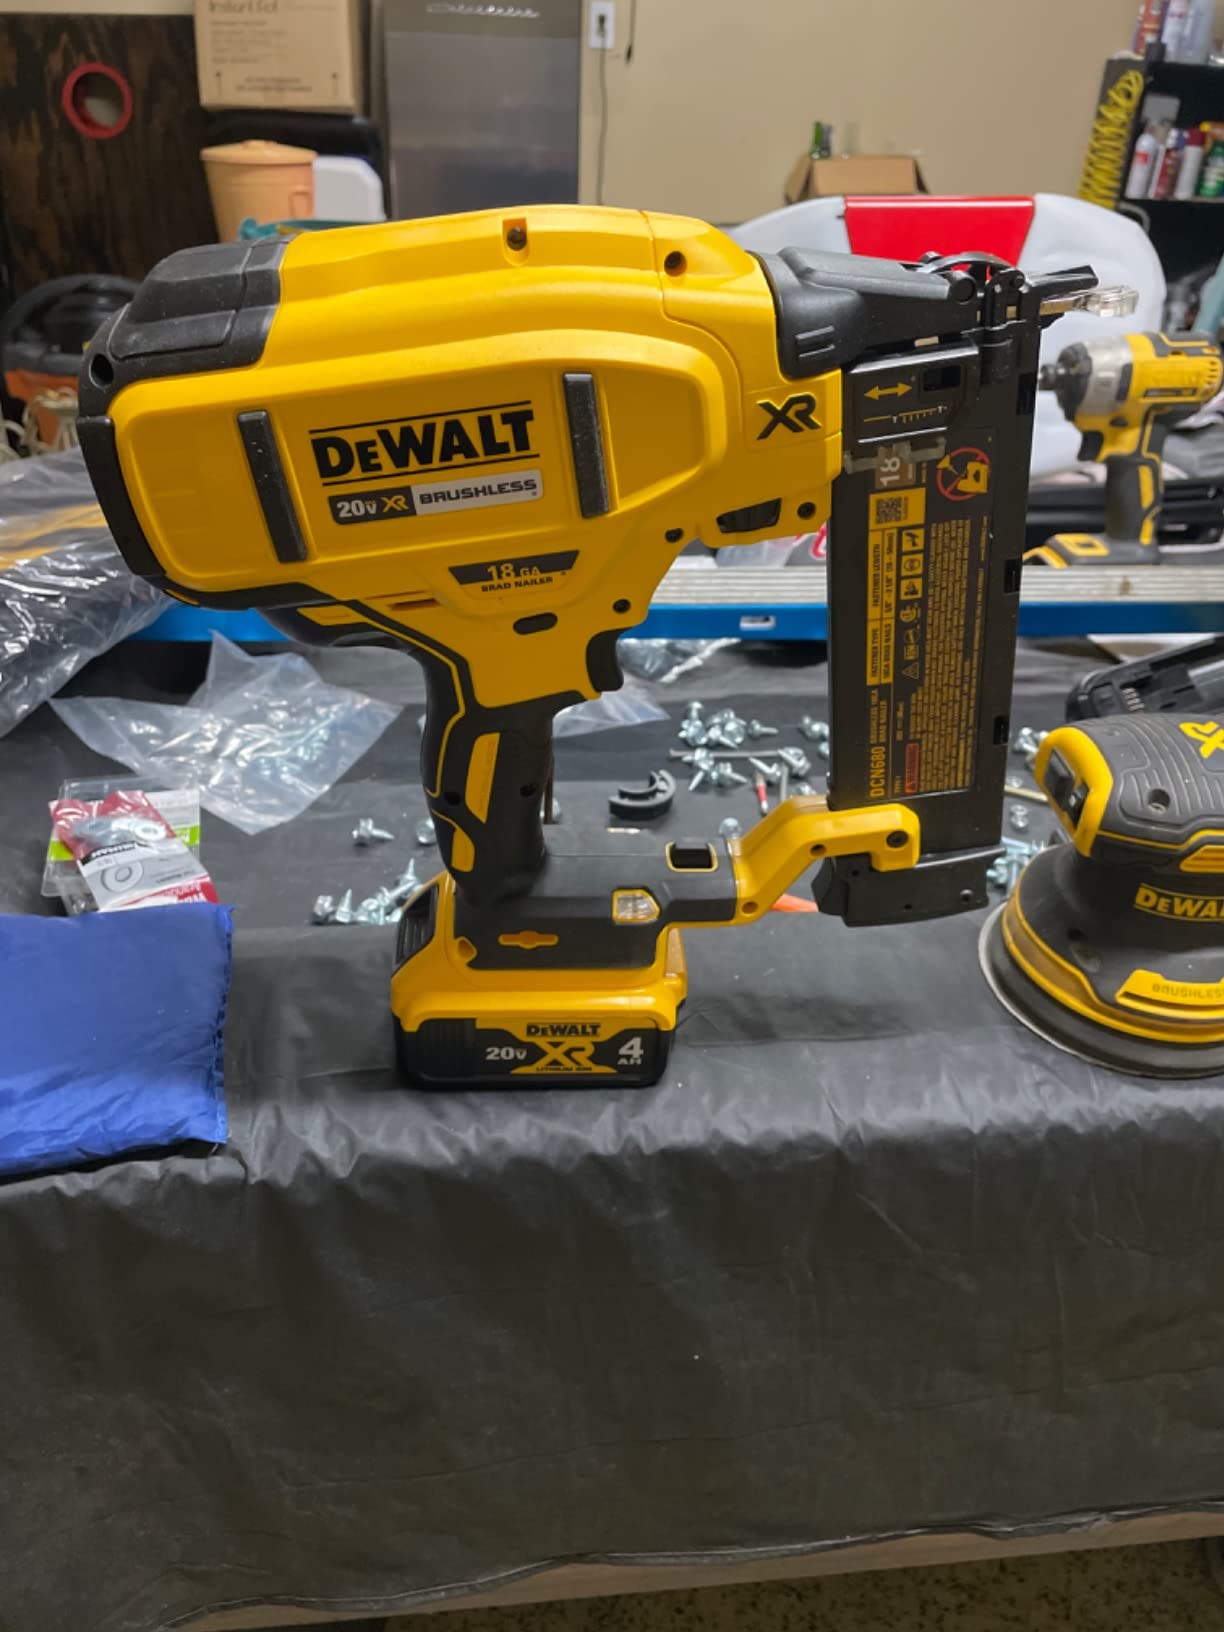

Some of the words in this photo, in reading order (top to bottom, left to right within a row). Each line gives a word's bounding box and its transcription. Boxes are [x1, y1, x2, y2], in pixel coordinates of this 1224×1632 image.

[756, 393, 822, 440] XR
[880, 457, 900, 486] 18
[381, 494, 410, 513] XR
[419, 479, 538, 505] BRUSHLESS
[481, 582, 512, 592] BRAD
[515, 576, 553, 588] NAILER
[487, 563, 515, 581] 18
[521, 566, 541, 577] GA
[869, 747, 885, 798] DCN680
[1135, 887, 1224, 919] DEWA
[532, 1041, 595, 1068] XR
[618, 1036, 644, 1059] 4
